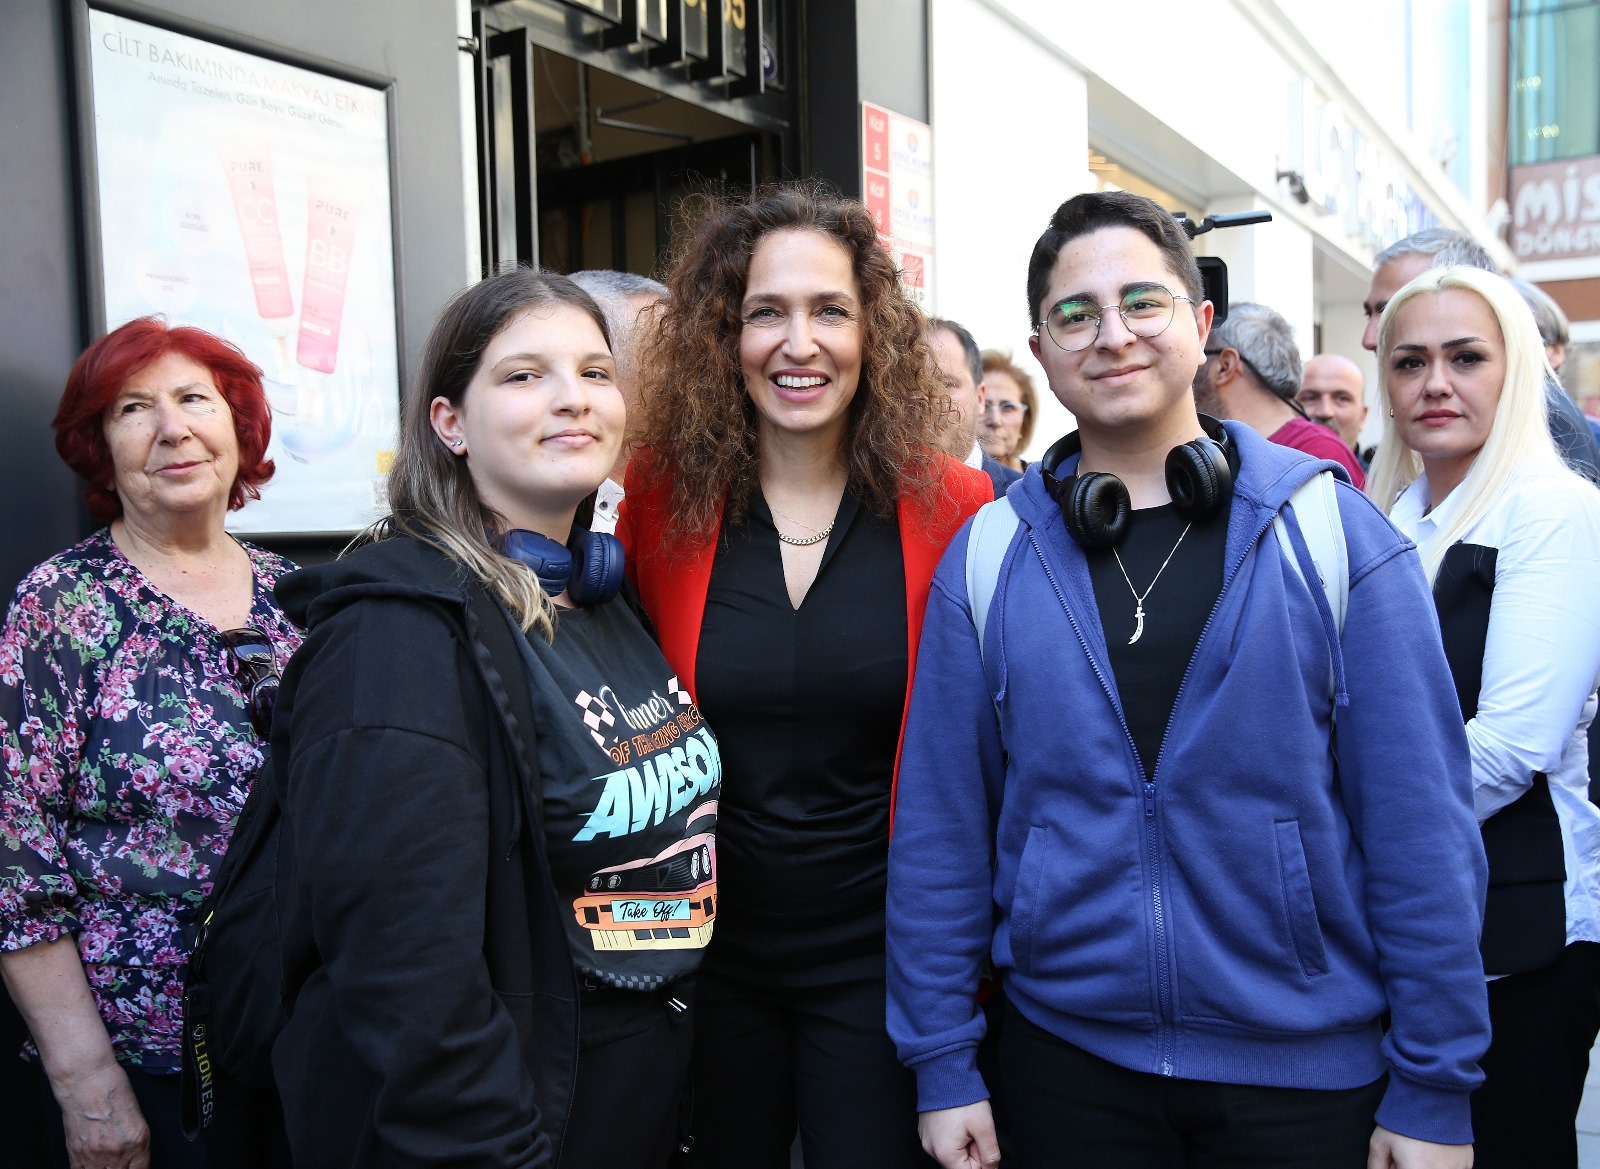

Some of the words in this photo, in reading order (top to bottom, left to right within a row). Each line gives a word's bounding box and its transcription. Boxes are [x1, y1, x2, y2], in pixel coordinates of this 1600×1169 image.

[102, 31, 142, 59] CİLT
[148, 43, 261, 89] BAKIMINDA
[263, 74, 330, 107] MAKYAJ
[230, 160, 264, 173] PURE
[240, 199, 276, 224] CC
[314, 200, 350, 221] PURE
[309, 239, 346, 274] BB
[599, 684, 675, 730] Inner
[609, 740, 631, 766] OF
[620, 901, 648, 920] Take
[653, 901, 682, 922] Off!
[195, 1040, 214, 1129] LIONESS
